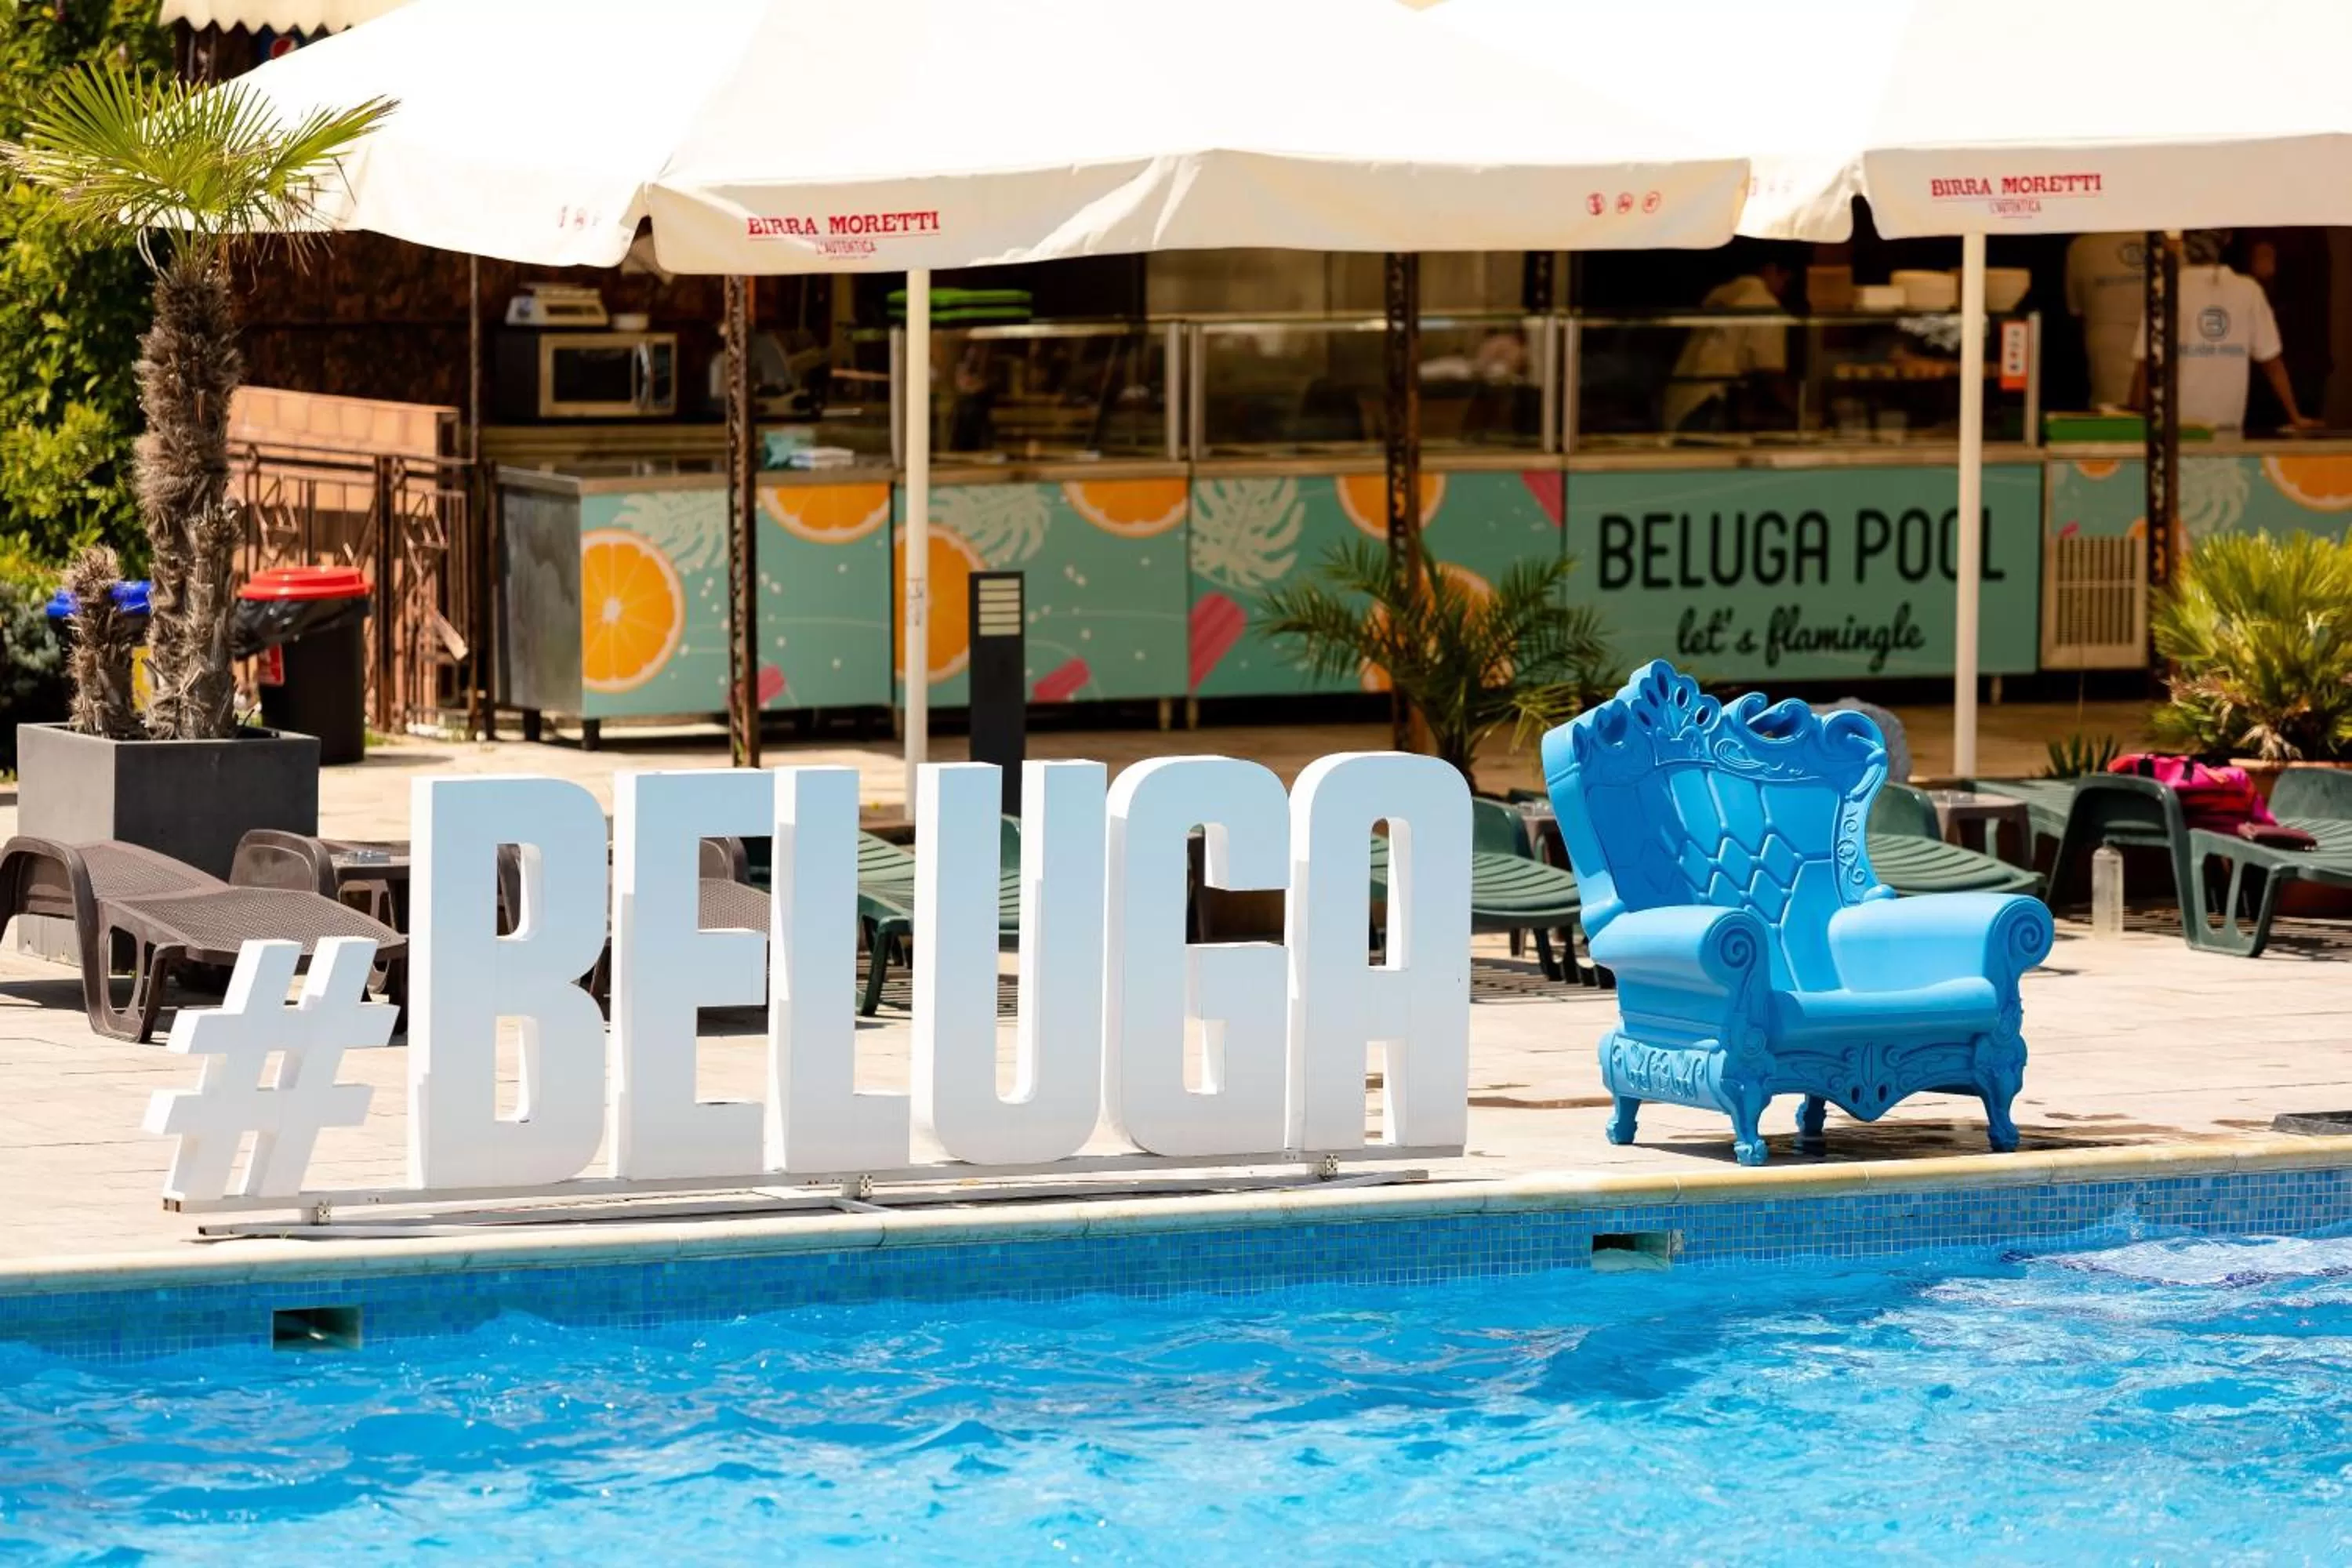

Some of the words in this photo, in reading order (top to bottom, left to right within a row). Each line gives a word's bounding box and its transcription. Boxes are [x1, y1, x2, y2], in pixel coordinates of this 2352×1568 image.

[1930, 178, 1992, 197] BIRRA
[2001, 174, 2102, 194] MORETTI
[747, 216, 818, 235] BIRRA
[829, 211, 940, 234] MORETTI
[1598, 510, 1829, 590] BELUGA
[1676, 606, 1759, 656] let's
[1764, 601, 1925, 671] flamingle
[143, 751, 1474, 1203] #BELUGA
